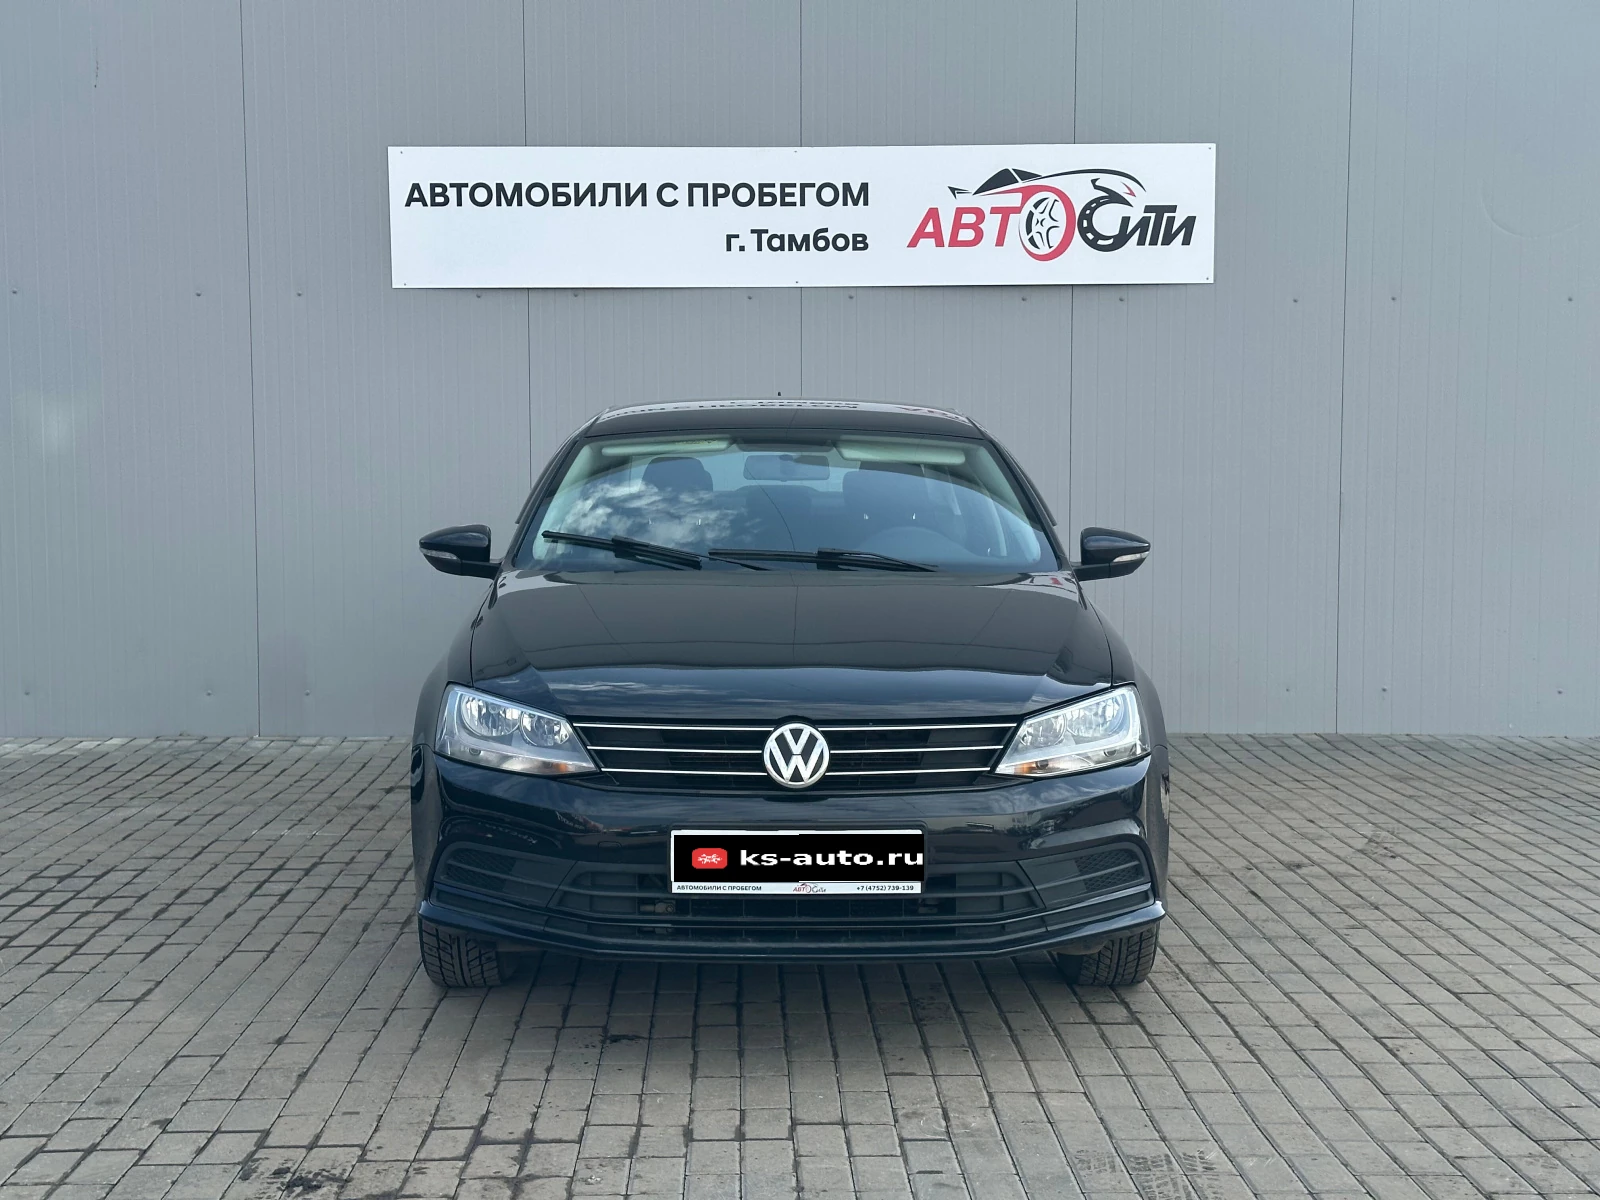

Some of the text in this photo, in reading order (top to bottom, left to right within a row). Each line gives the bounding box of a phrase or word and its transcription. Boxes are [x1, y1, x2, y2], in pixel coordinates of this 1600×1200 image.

[405, 182, 868, 207] АВТОМОБИЛИ С ПРОБЕГОМ
[726, 228, 868, 252] г. Тамбов
[676, 884, 722, 892] АВТОМОБИЛИ
[728, 884, 762, 892] ПРОБЕГОМ
